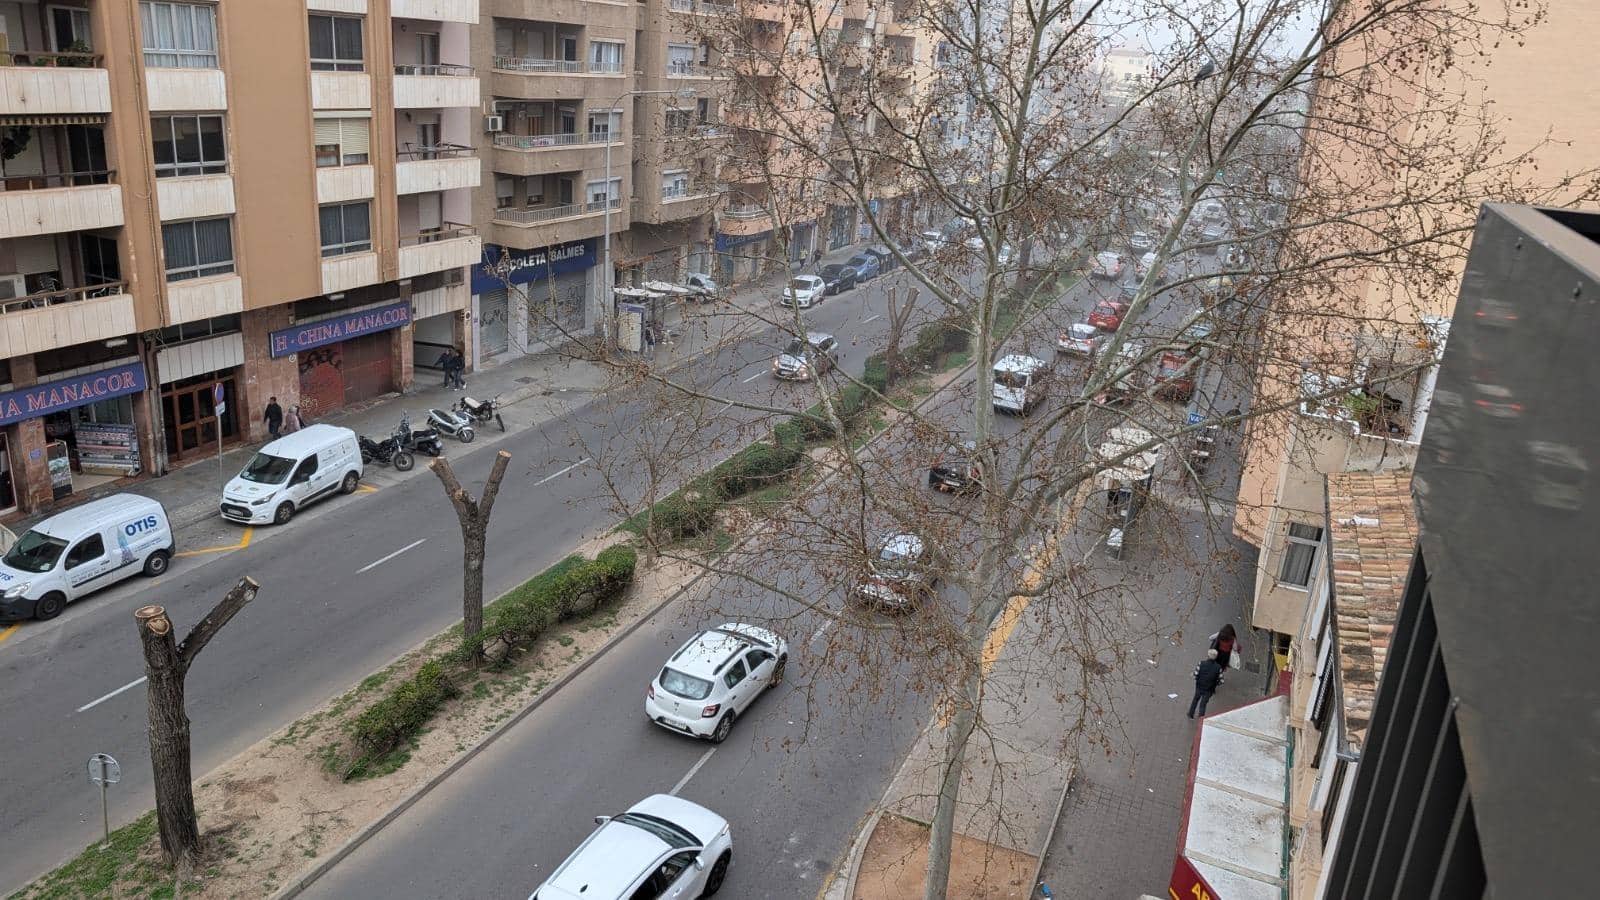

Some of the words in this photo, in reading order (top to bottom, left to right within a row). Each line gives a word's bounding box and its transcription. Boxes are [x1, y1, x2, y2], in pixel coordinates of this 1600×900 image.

[550, 245, 585, 262] BALMES
[275, 335, 288, 352] H
[297, 321, 342, 346] CHINA
[345, 307, 408, 334] MANACOR
[26, 371, 136, 412] MANACOR
[125, 515, 157, 537] OTIS
